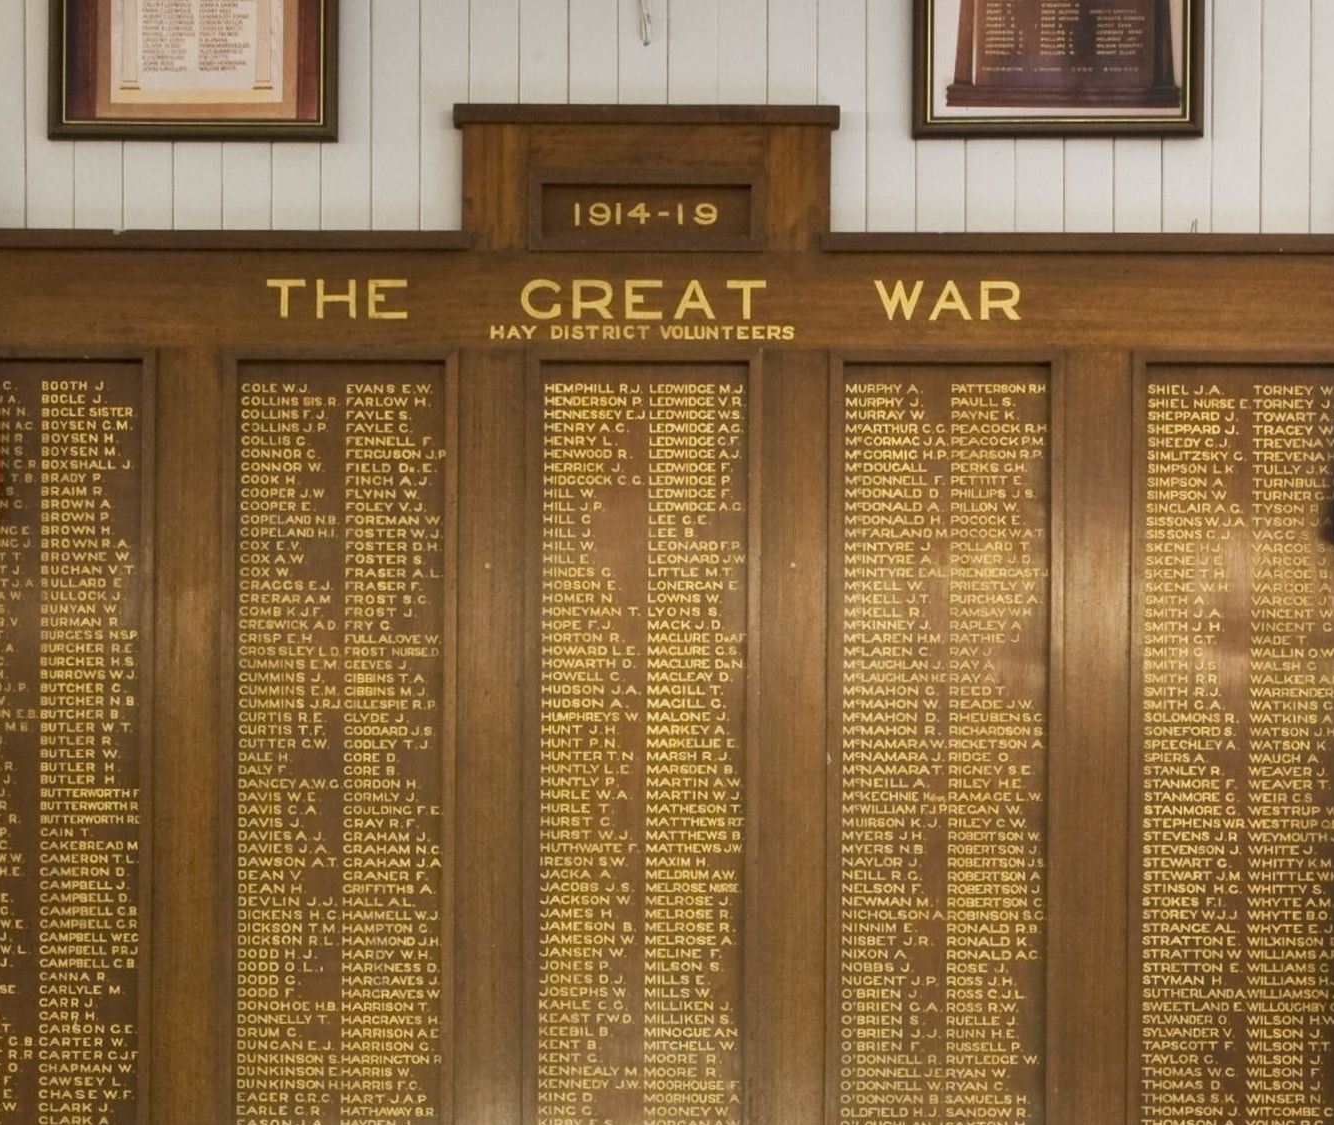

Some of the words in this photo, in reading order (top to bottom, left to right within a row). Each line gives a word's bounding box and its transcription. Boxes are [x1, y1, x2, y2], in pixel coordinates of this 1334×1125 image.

[575, 203, 717, 225] 1914-19
[267, 279, 407, 319] THE
[521, 279, 766, 319] GREAT
[875, 280, 1021, 320] WAR
[490, 325, 537, 339] HAY
[551, 325, 650, 339] DISTRICT
[660, 326, 794, 340] VOLUNTEERS
[346, 397, 408, 407] FARLOW
[846, 397, 903, 407] MURPHY
[951, 397, 998, 406] PAULL
[1148, 399, 1189, 408] SHIEL
[1194, 399, 1235, 409] NURSE
[346, 410, 394, 420] FAYLE
[1252, 425, 1313, 435] TRACEY
[42, 433, 98, 443] BOYSEN
[544, 436, 596, 446] HENRY
[544, 463, 603, 472] HERRICK
[947, 963, 987, 973] ROSE
[645, 975, 689, 985] MILLS
[645, 1014, 714, 1024] MILLIKEN
[39, 1077, 105, 1086] CAWSEY
